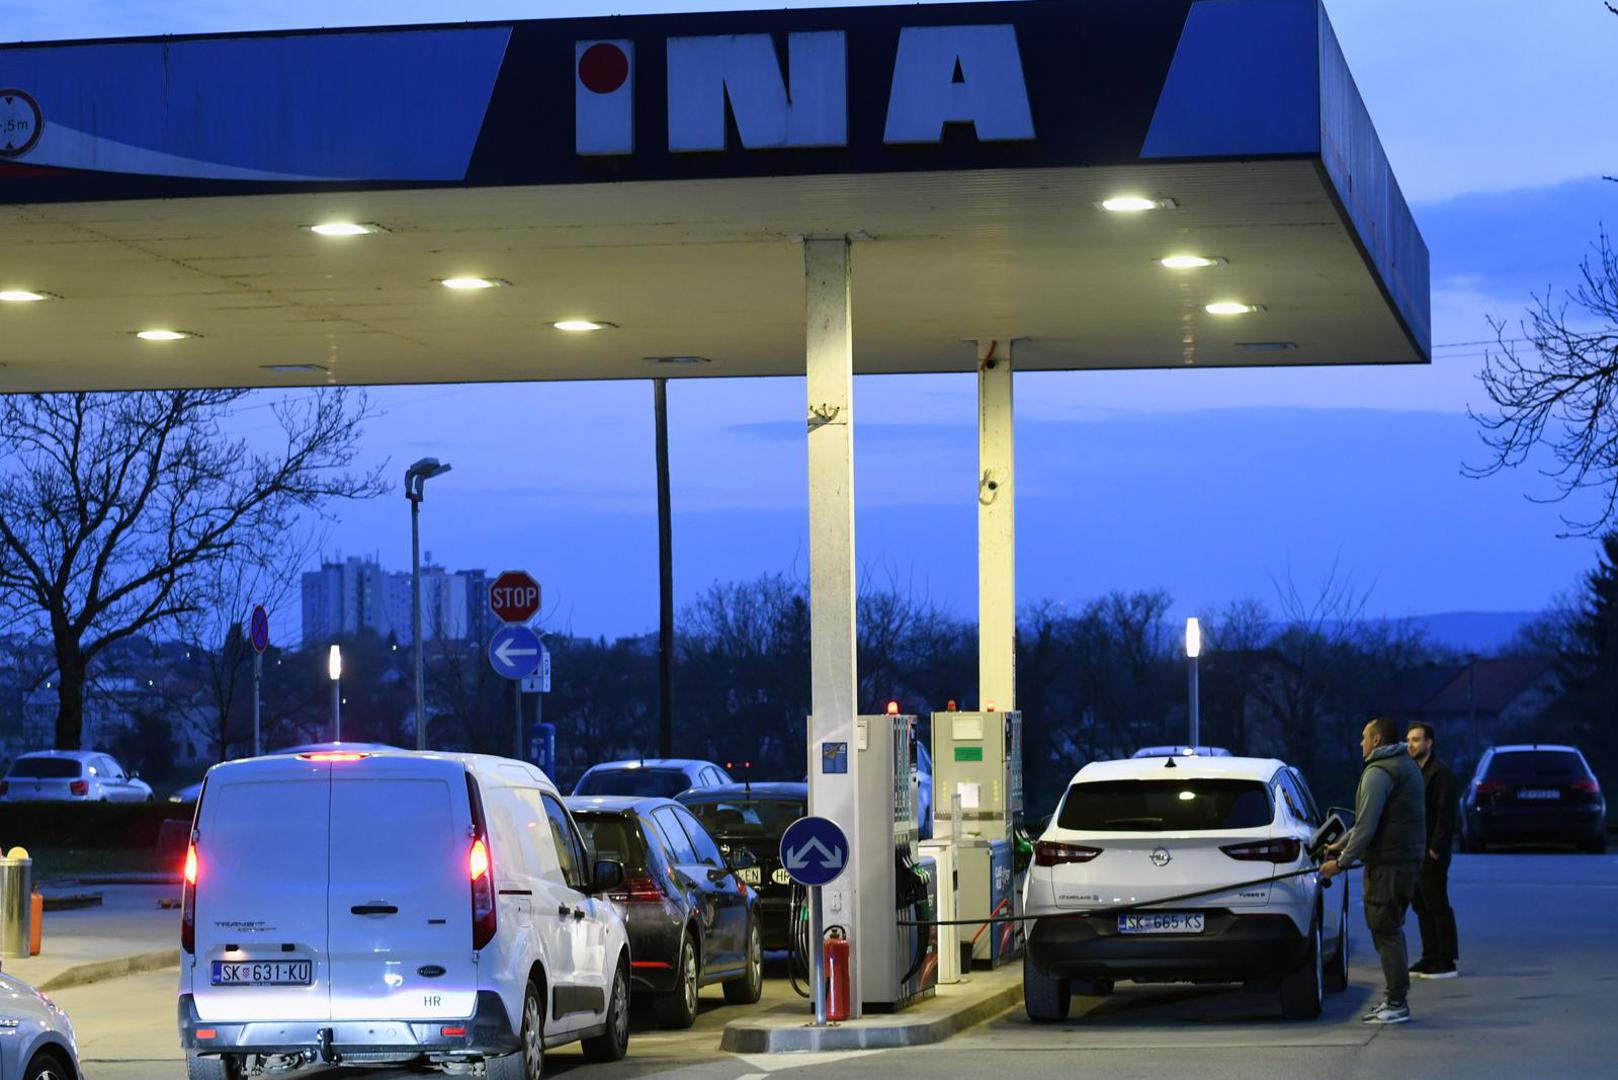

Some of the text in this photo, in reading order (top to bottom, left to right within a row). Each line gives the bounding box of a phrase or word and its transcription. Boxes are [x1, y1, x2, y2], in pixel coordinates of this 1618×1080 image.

[493, 587, 537, 608] STOP
[1128, 914, 1143, 929] SK
[223, 964, 308, 981] SK 631-KU
[424, 996, 442, 1007] HR
